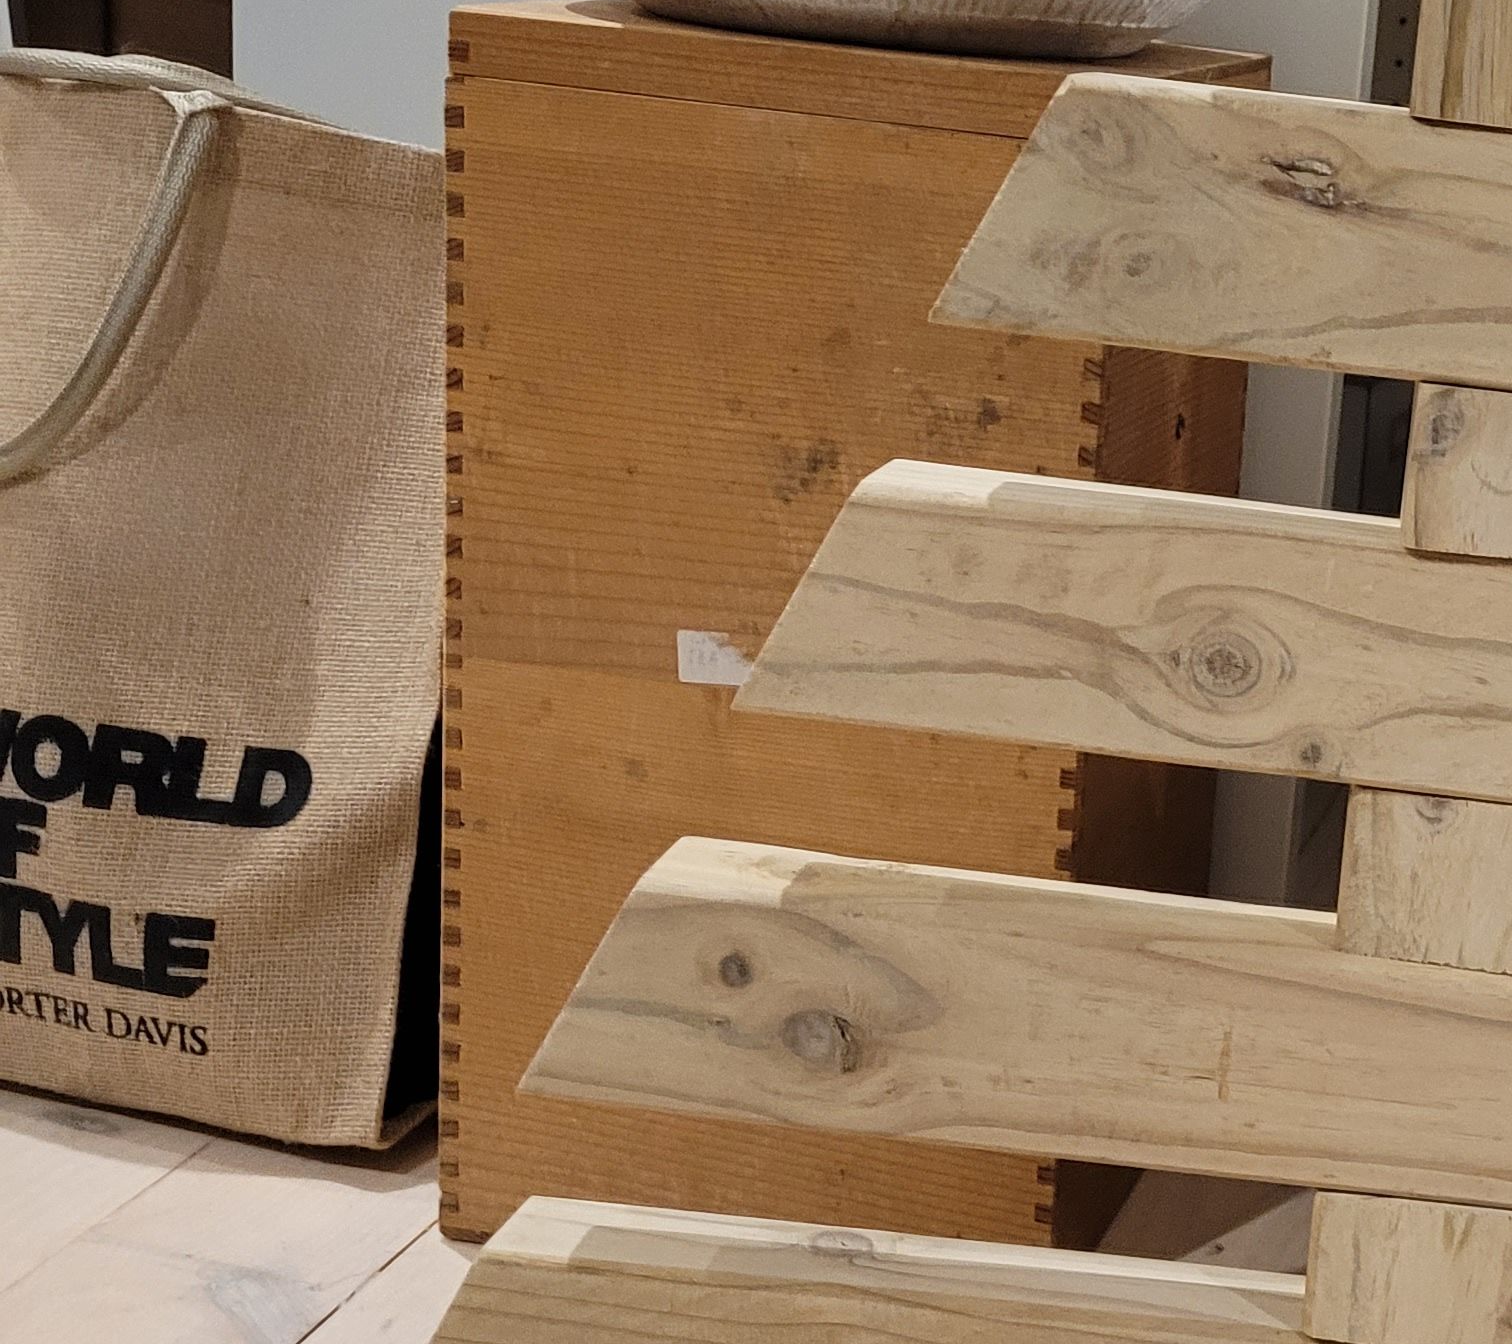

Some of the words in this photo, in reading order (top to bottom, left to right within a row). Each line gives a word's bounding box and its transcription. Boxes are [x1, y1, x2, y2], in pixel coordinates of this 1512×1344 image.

[0, 797, 47, 879] F
[0, 884, 215, 998] TYLE
[0, 986, 95, 1032] RTER
[106, 1008, 209, 1055] DAVIS
